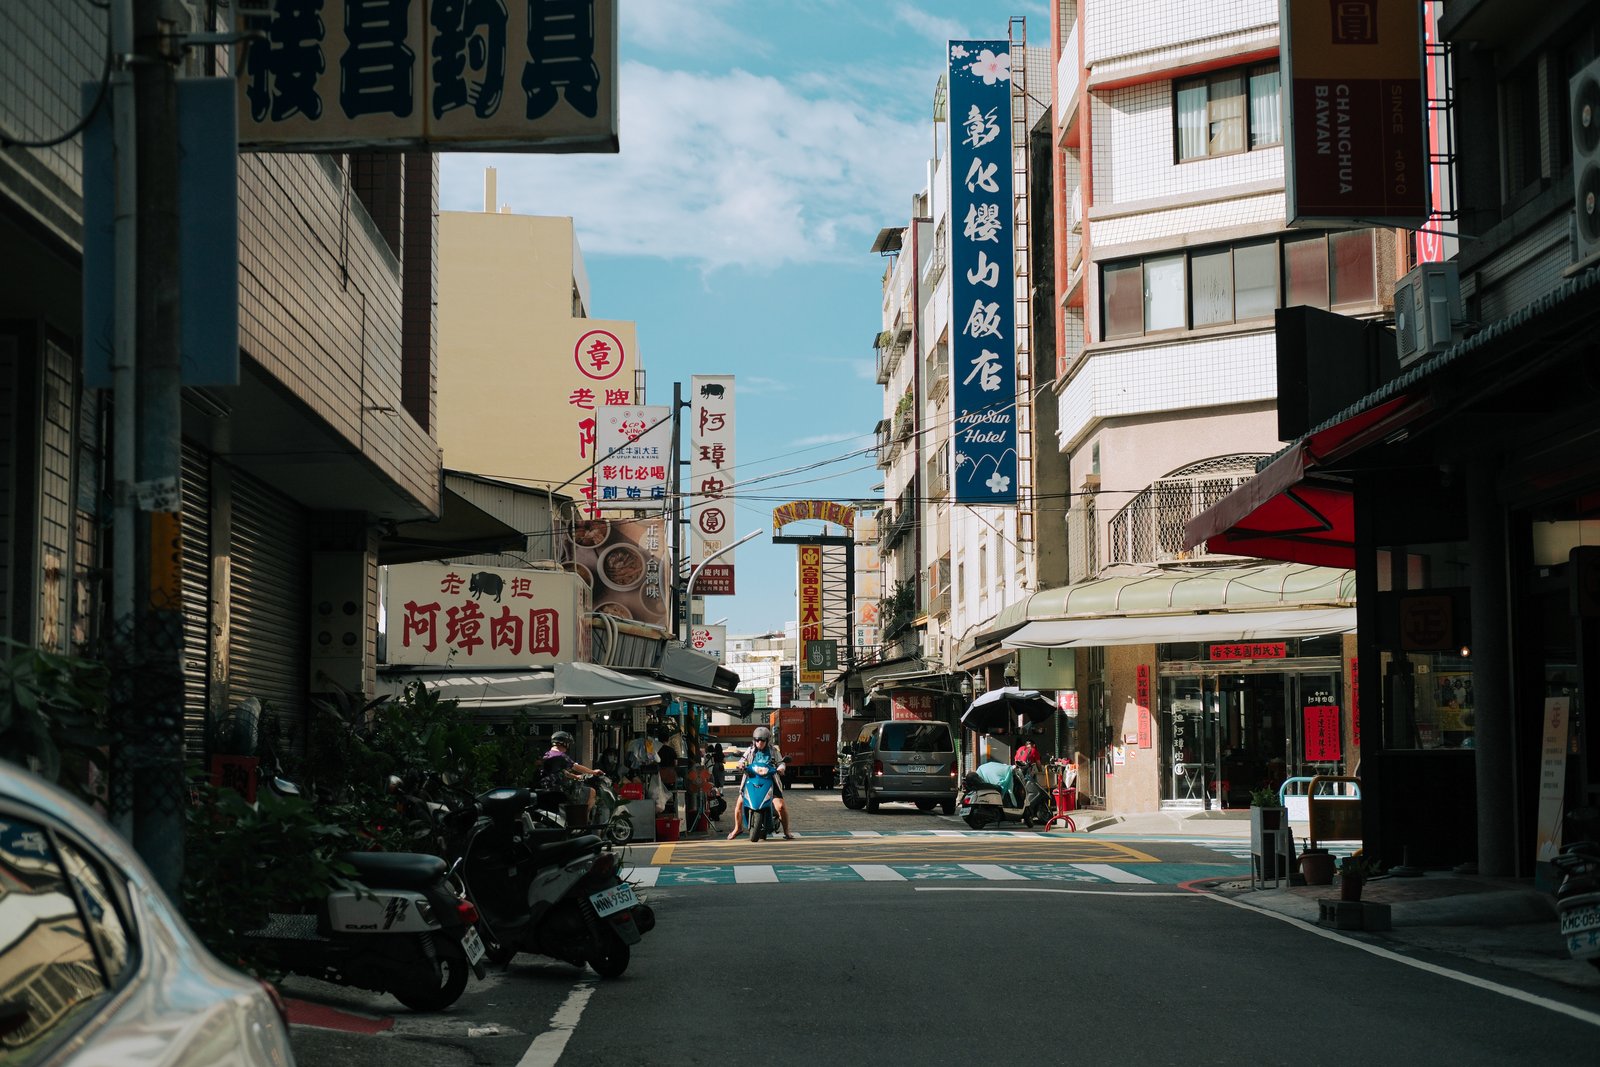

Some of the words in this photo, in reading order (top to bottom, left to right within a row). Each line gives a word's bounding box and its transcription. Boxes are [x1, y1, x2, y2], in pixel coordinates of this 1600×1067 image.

[1314, 85, 1331, 156] BAWAN
[1391, 85, 1404, 134] SINCE
[962, 104, 1004, 392] 彰化櫻山飯店
[586, 340, 611, 371] 章
[964, 427, 1006, 444] Hotel
[602, 465, 665, 481] 彰化必喝
[602, 486, 666, 500] 創始店
[402, 600, 560, 657] 阿璋肉圓
[802, 565, 819, 661] 富皇大飯
[786, 733, 801, 743] 397
[593, 889, 633, 913] MNN-9357
